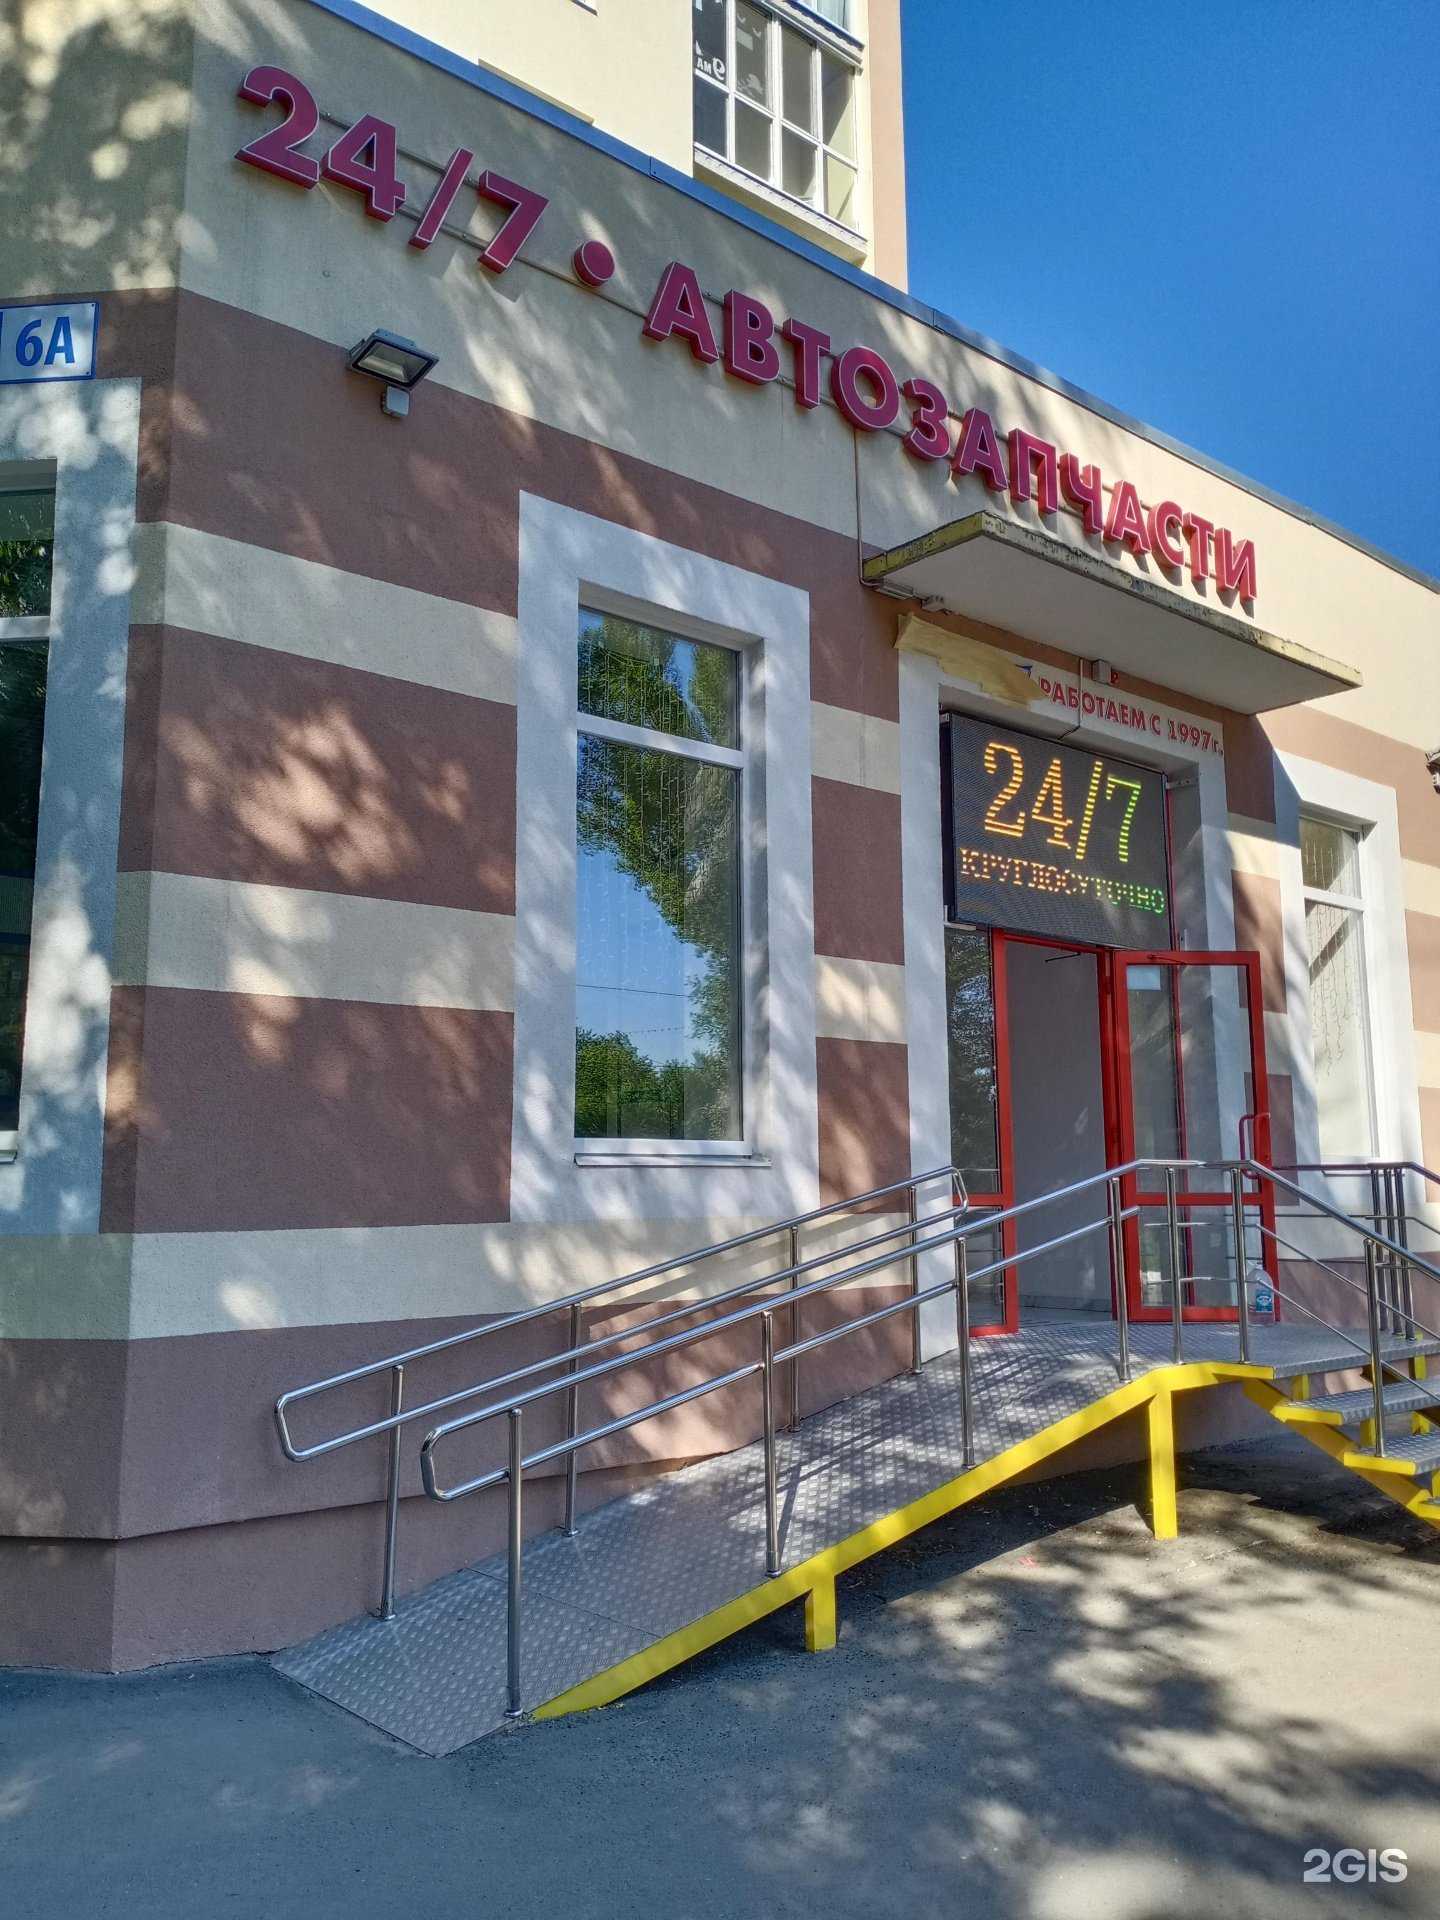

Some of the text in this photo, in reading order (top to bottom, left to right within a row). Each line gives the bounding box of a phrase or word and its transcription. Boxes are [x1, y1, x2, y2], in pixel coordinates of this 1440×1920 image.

[16, 316, 75, 367] 6А
[234, 65, 1257, 600] 24/7 АВТОЗАПЧАСТИ
[1039, 677, 1146, 731] РАБОТАЕМ
[1150, 713, 1161, 736] С
[983, 742, 1142, 863] 24/7
